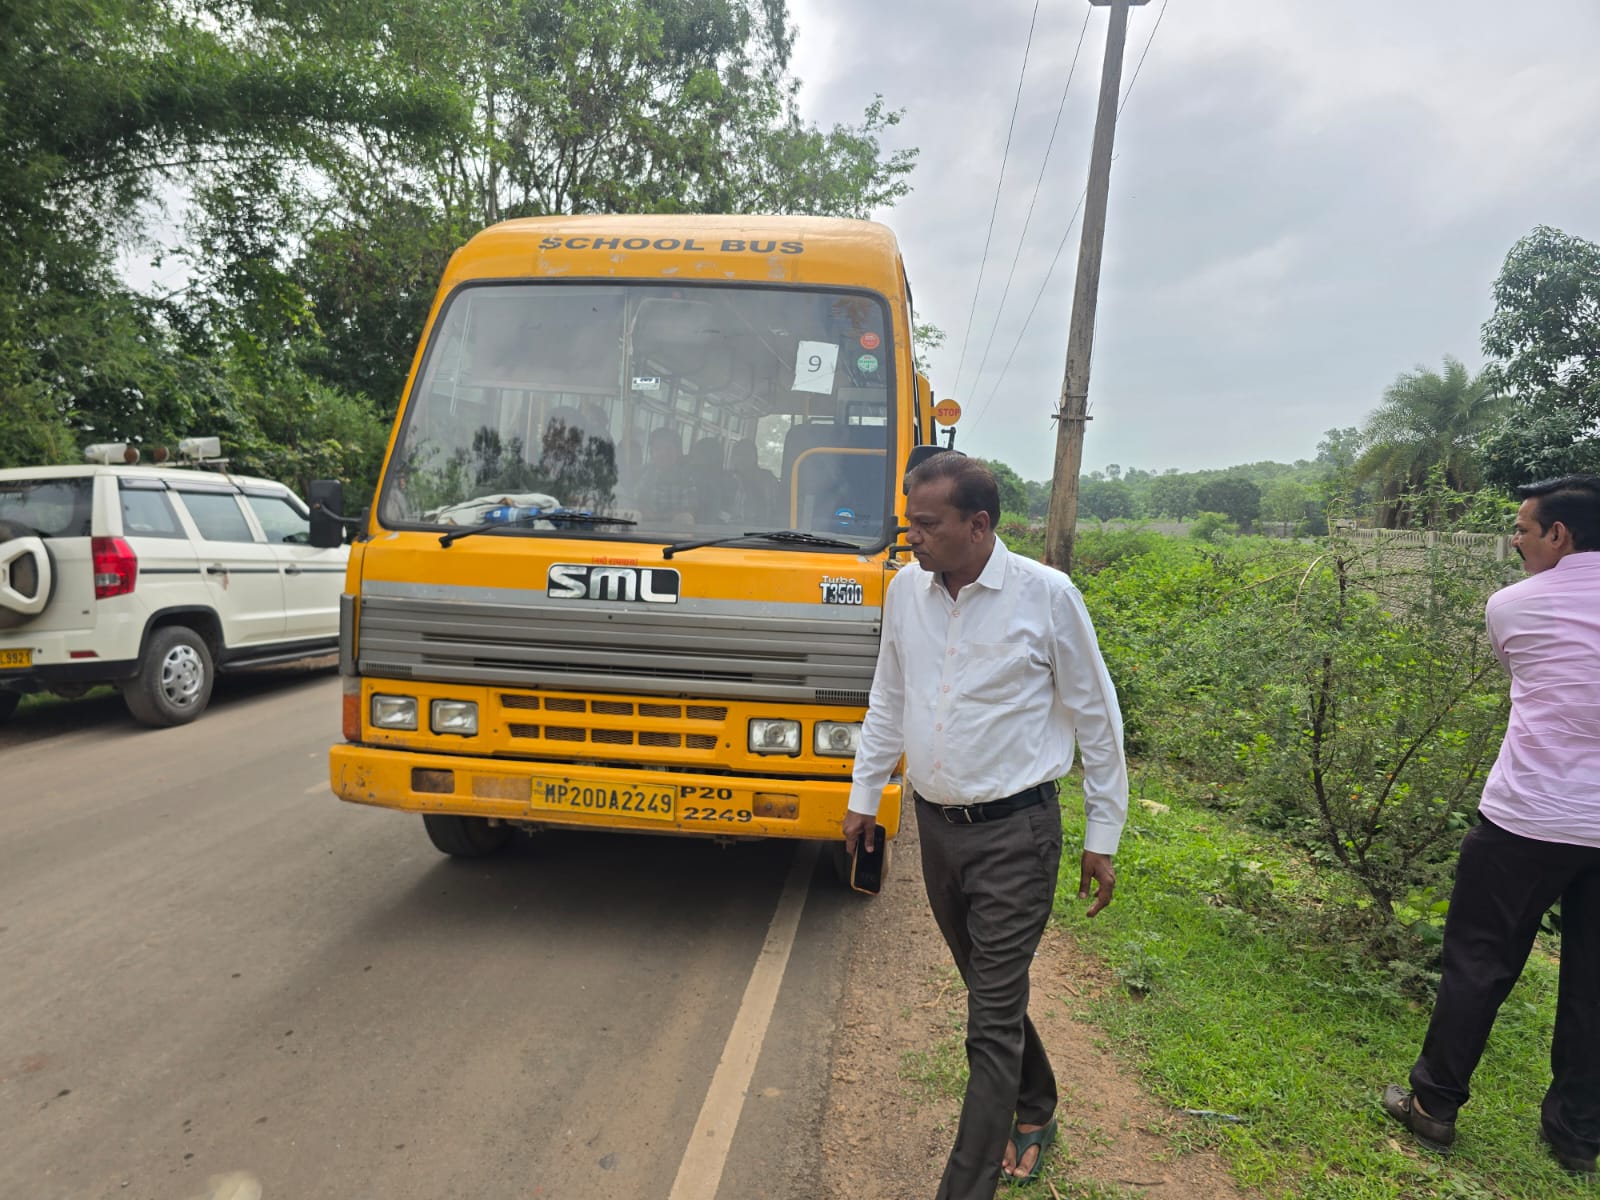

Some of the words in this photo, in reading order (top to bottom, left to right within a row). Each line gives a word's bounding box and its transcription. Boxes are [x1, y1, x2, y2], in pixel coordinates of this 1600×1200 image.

[538, 237, 705, 252] SCHOOL
[719, 239, 805, 254] BUS
[807, 355, 822, 373] 9
[937, 407, 961, 417] STOP
[548, 564, 678, 604] SML
[822, 575, 857, 584] Turbo
[820, 583, 863, 605] T3500
[544, 782, 672, 814] MP20DA2249
[680, 785, 733, 801] P20
[683, 806, 753, 823] 2249
